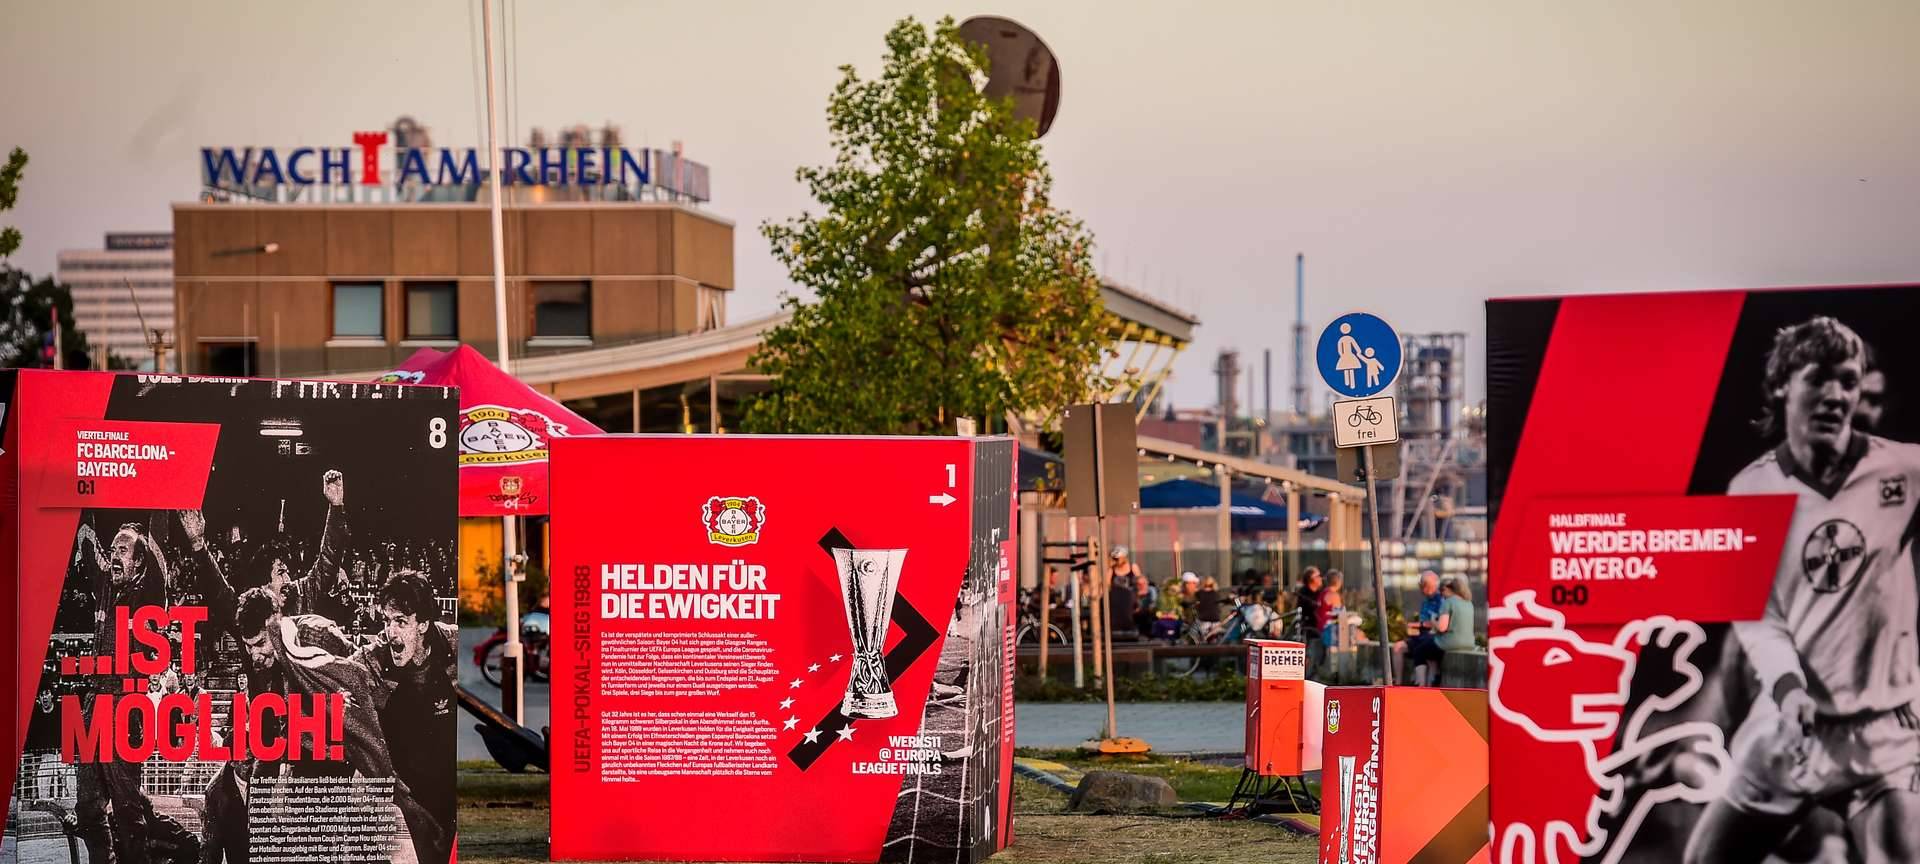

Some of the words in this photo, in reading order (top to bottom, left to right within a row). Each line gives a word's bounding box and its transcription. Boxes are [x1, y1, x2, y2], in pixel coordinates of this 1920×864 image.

[400, 147, 481, 185] AM
[503, 146, 652, 185] RHEIN
[471, 411, 506, 420] 1904
[77, 430, 129, 441] VIERTELFINALE
[428, 417, 447, 450] 8
[467, 433, 528, 443] BAYER
[1358, 428, 1377, 439] frei
[78, 443, 93, 458] FC
[94, 444, 168, 460] BARCELONA
[460, 450, 549, 463] everkuse
[78, 461, 118, 477] BAYER
[119, 462, 137, 478] 04
[946, 464, 956, 488] 1
[78, 480, 95, 495] 0:1
[1550, 513, 1626, 527] HALBFINALE
[1550, 530, 1646, 554] WERDER
[1648, 528, 1743, 552] BREMEN
[601, 564, 708, 590] HELDEN
[712, 559, 767, 590] FÜR
[1550, 558, 1624, 580] BAYER
[1625, 557, 1658, 580] 04
[574, 565, 592, 608] 1988
[1551, 585, 1588, 606] 0:0
[601, 593, 644, 619] DIE
[649, 593, 781, 619] EWIGKEIT
[1264, 656, 1305, 666] BREMER
[574, 611, 592, 774] UEFA-POKAL-SIEG
[61, 679, 344, 764] MÖGLICH!
[889, 735, 942, 748] WERKS11
[1370, 696, 1381, 784] FINALS
[879, 748, 892, 762] @
[895, 749, 942, 762] EUROPA
[852, 762, 898, 775] LEAGUE
[900, 763, 942, 775] FINALS
[1361, 760, 1372, 857] EUROPA
[1368, 787, 1379, 864] EAGUE
